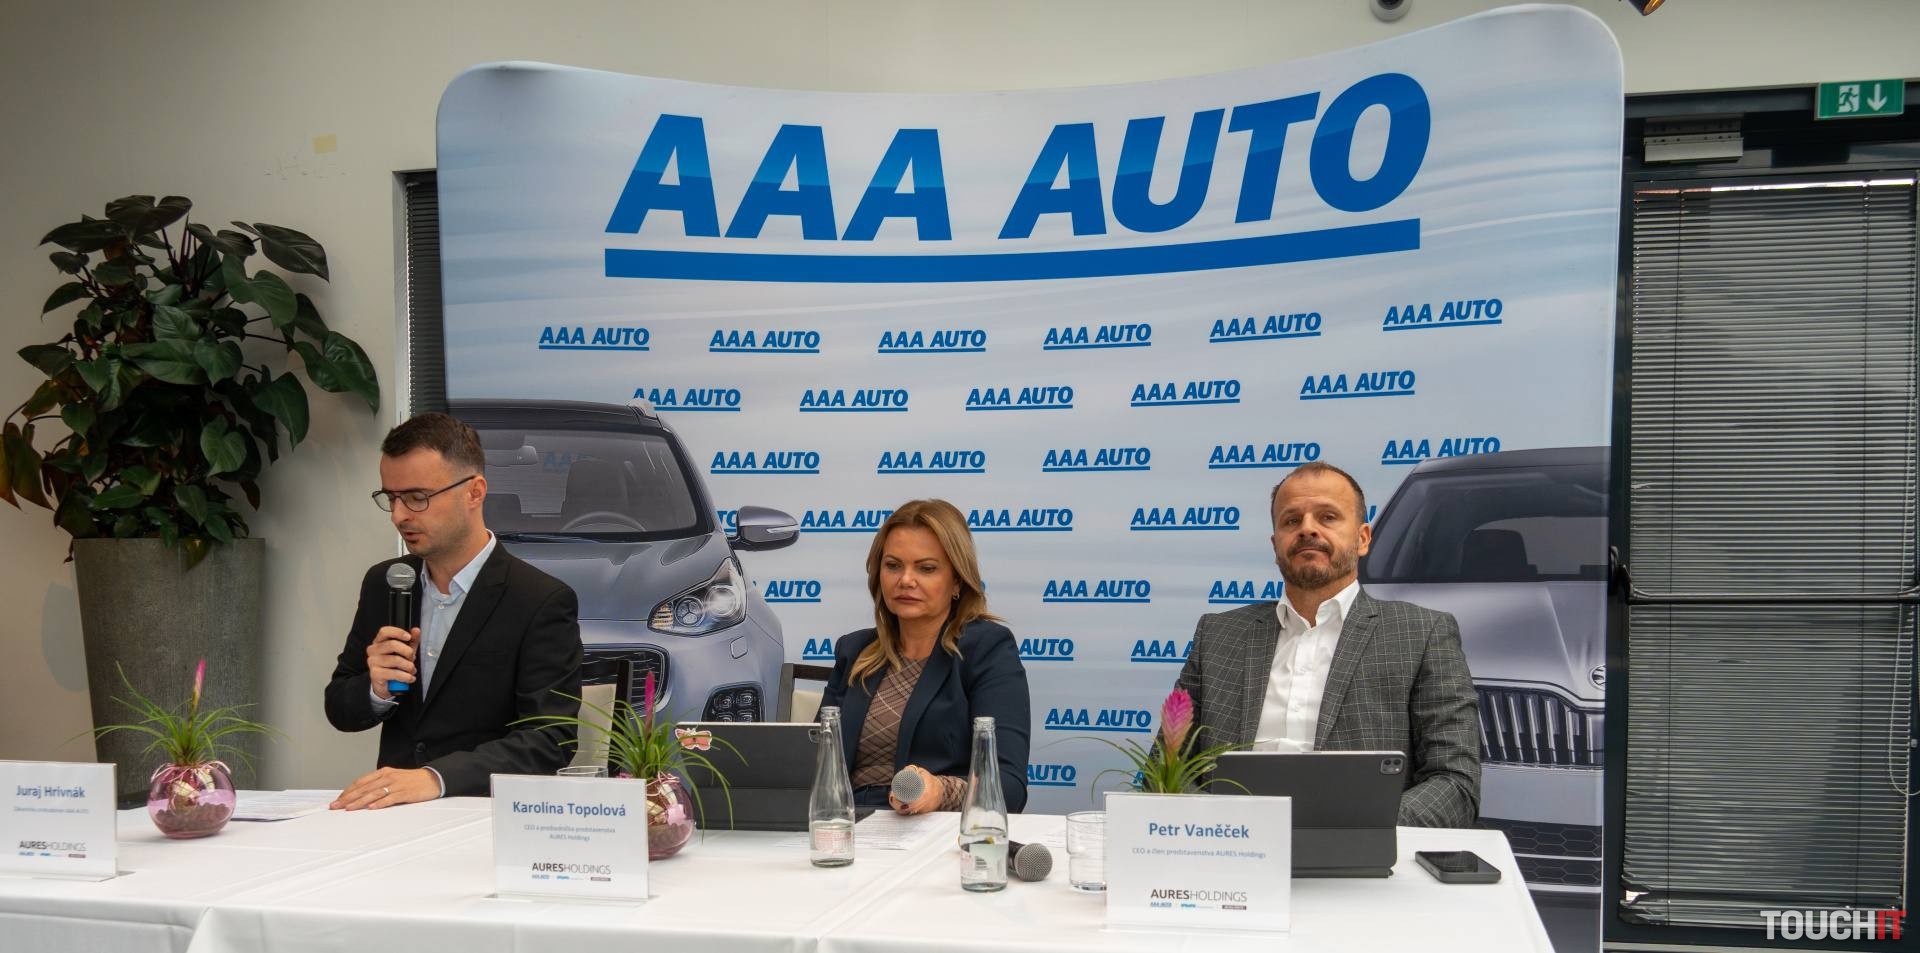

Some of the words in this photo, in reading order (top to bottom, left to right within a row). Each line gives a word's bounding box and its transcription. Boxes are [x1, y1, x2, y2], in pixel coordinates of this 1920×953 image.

[604, 113, 953, 242] AAA
[997, 72, 1432, 241] AUTO
[1383, 304, 1432, 325] AAA
[1439, 298, 1502, 321] AUTO
[1210, 317, 1256, 337] AAA
[1262, 312, 1321, 334] AUTO
[539, 326, 585, 344] AAA
[591, 327, 649, 346] AUTO
[709, 330, 756, 347] AAA
[762, 331, 820, 348] AUTO
[878, 331, 924, 348] AAA
[930, 330, 986, 348] AUTO
[1043, 327, 1089, 345] AAA
[1095, 323, 1151, 343] AUTO
[1131, 383, 1176, 401] AAA
[1182, 379, 1240, 399] AUTO
[1300, 374, 1348, 394] AAA
[1354, 370, 1415, 391] AUTO
[683, 388, 741, 407] AUTO
[800, 390, 845, 407] AAA
[851, 389, 908, 407] AUTO
[966, 388, 1011, 405] AAA
[1017, 386, 1073, 404] AUTO
[1042, 449, 1088, 467] AAA
[1094, 447, 1151, 466] AUTO
[1209, 445, 1255, 463] AAA
[1261, 442, 1321, 462] AUTO
[1382, 439, 1431, 459] AAA
[1437, 437, 1501, 458] AUTO
[711, 451, 756, 469] AAA
[762, 451, 820, 469] AUTO
[878, 451, 923, 468] AAA
[929, 451, 985, 468] AUTO
[800, 510, 846, 527] AAA
[852, 510, 893, 528] AUT
[967, 509, 1011, 527] AAA
[1016, 508, 1073, 526] AUTO
[1131, 507, 1176, 525] AAA
[1182, 506, 1240, 525] AUTO
[764, 580, 821, 598] AUTO
[1043, 580, 1088, 597] AAA
[1094, 580, 1151, 598] AUTO
[1208, 580, 1255, 598] AAA
[803, 638, 833, 655] AA
[1018, 638, 1074, 656] AUTO
[1131, 640, 1177, 657] AAA
[1045, 708, 1090, 726] AAA
[1095, 709, 1152, 728] AUTO
[1026, 763, 1076, 782] AUTO
[16, 785, 42, 799] Juraj
[44, 786, 86, 799] Hrivnák
[567, 803, 626, 818] Topolová
[1149, 822, 1181, 837] Petr
[1184, 823, 1250, 839] Vaněček
[1132, 847, 1146, 855] CEO
[1216, 850, 1238, 858] AURES
[1238, 851, 1266, 860] Holdings
[1150, 888, 1248, 903] AURESHOLDINGS
